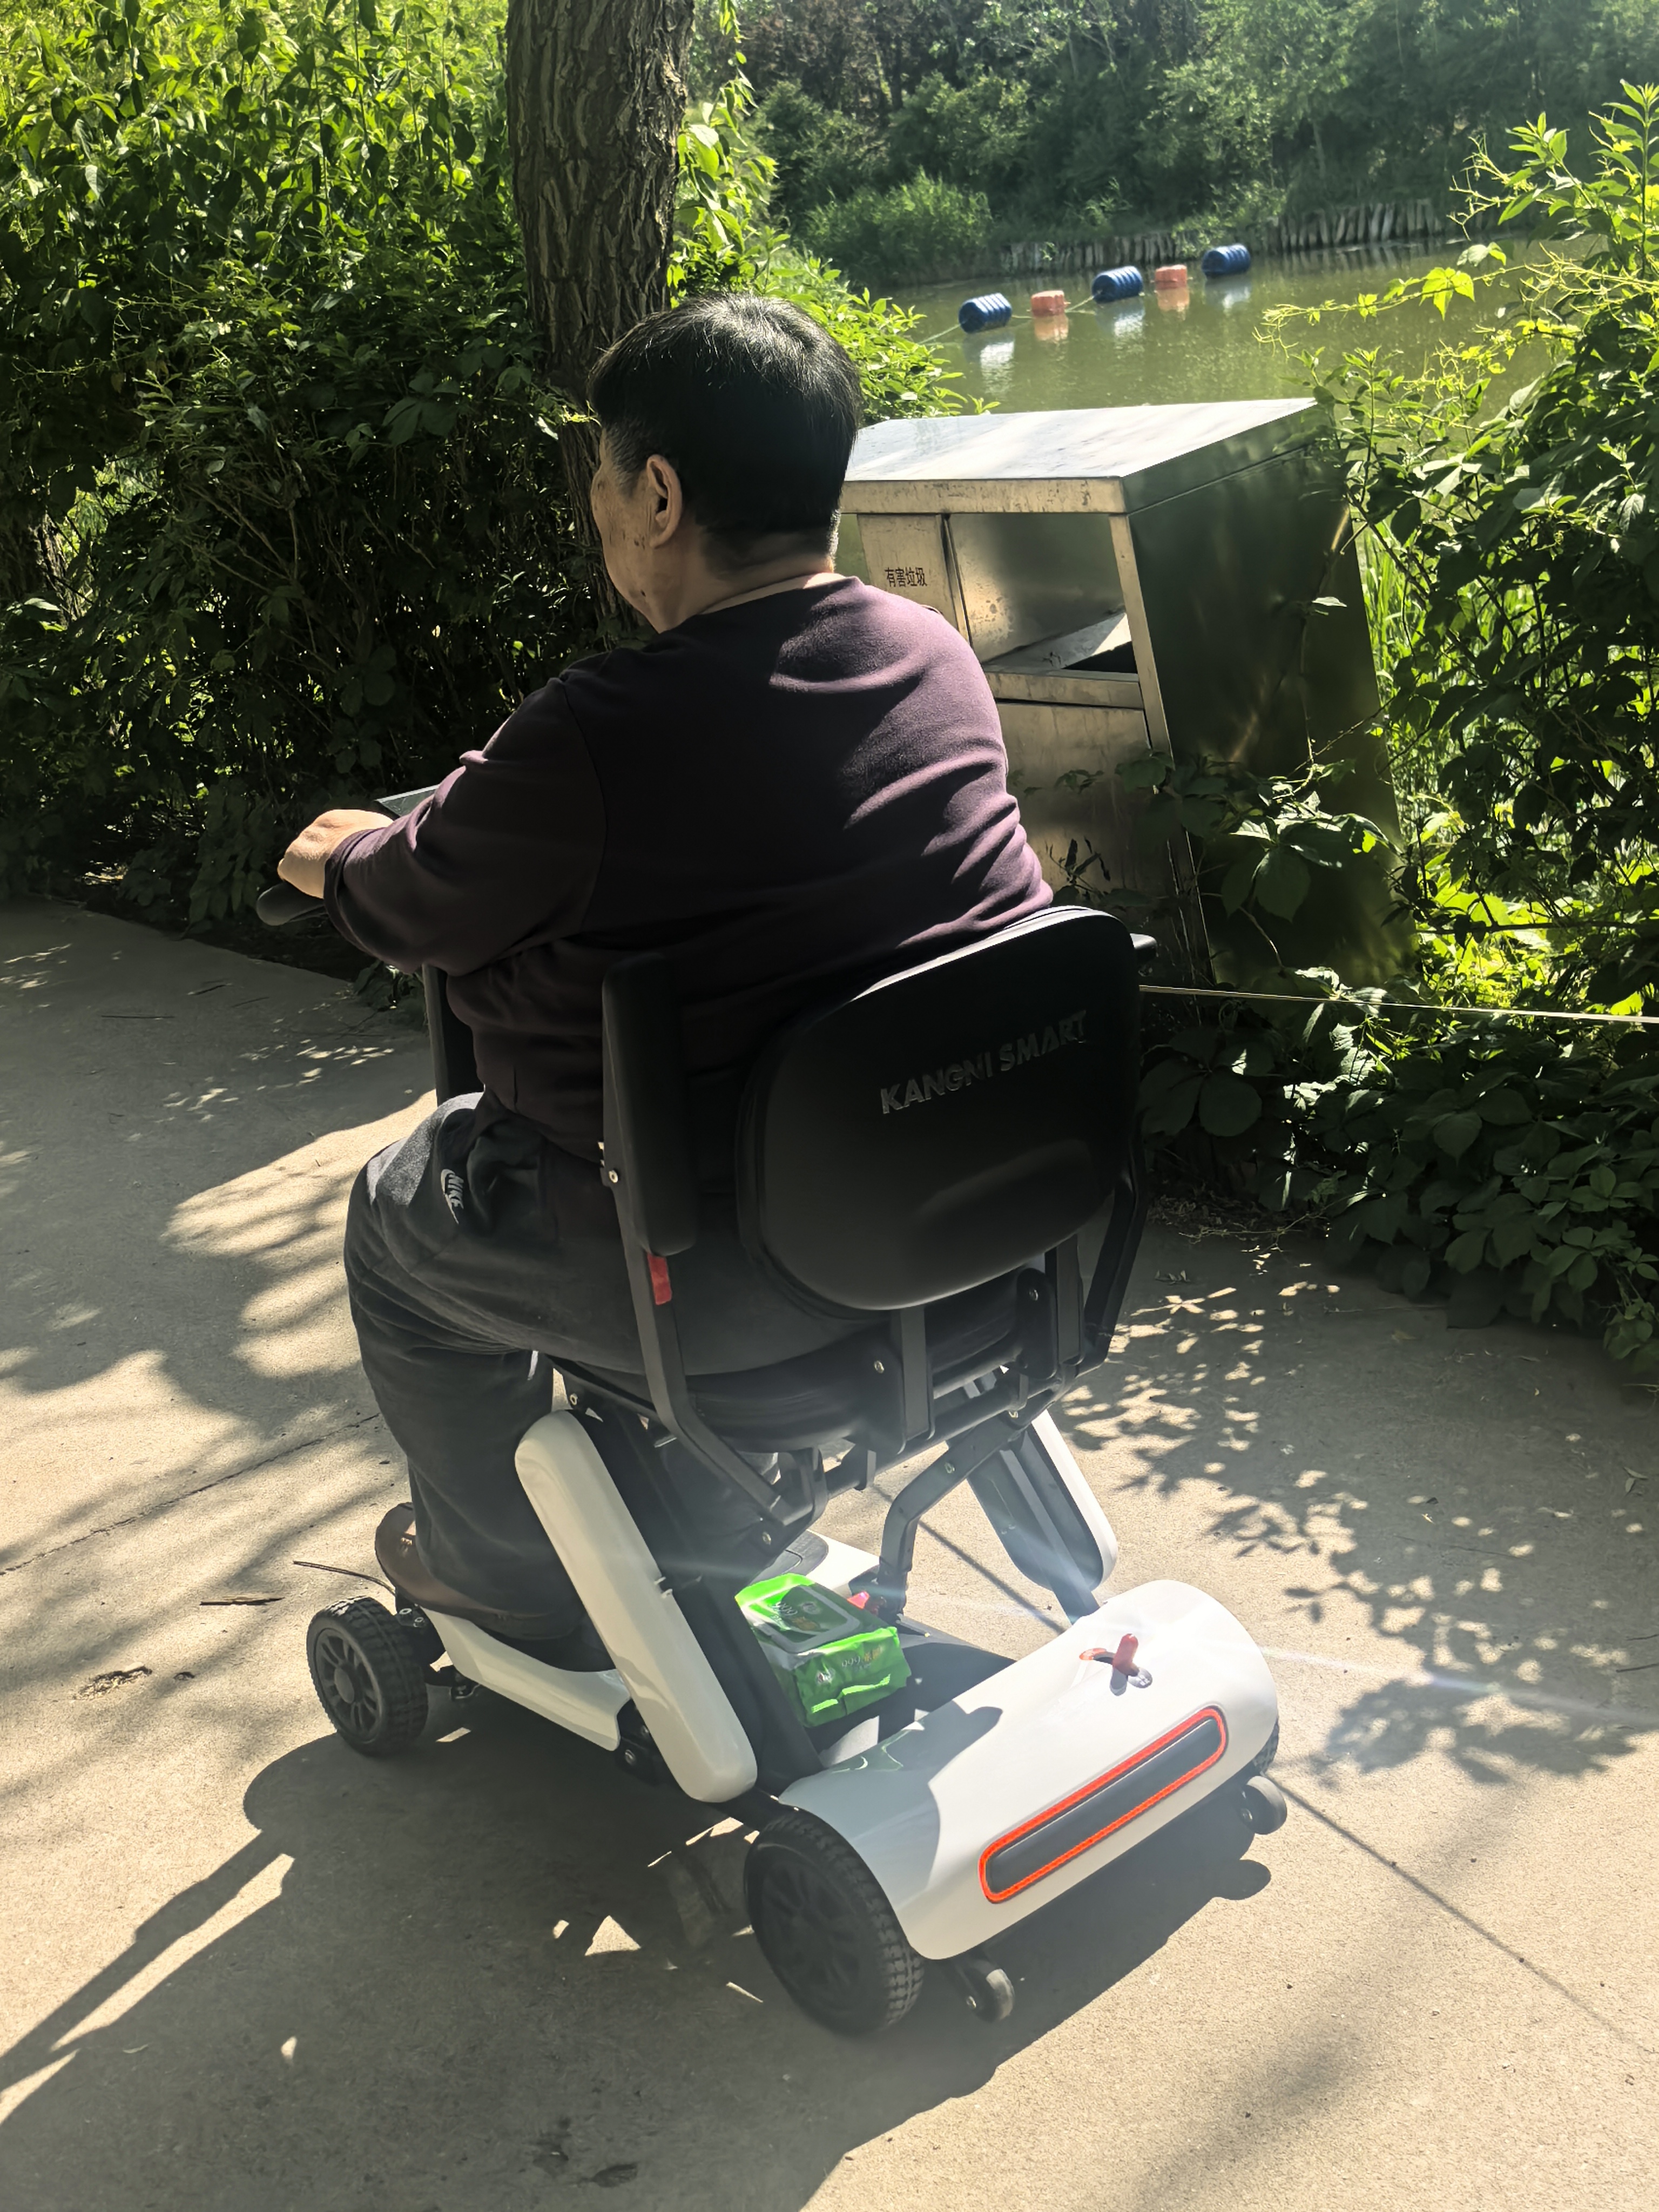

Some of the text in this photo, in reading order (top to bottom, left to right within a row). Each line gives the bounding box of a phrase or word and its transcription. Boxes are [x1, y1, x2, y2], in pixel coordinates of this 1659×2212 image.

[885, 567, 927, 588] 有害垃圾
[880, 1009, 1087, 1114] KANGNI SMART
[447, 1173, 464, 1210] NIKE
